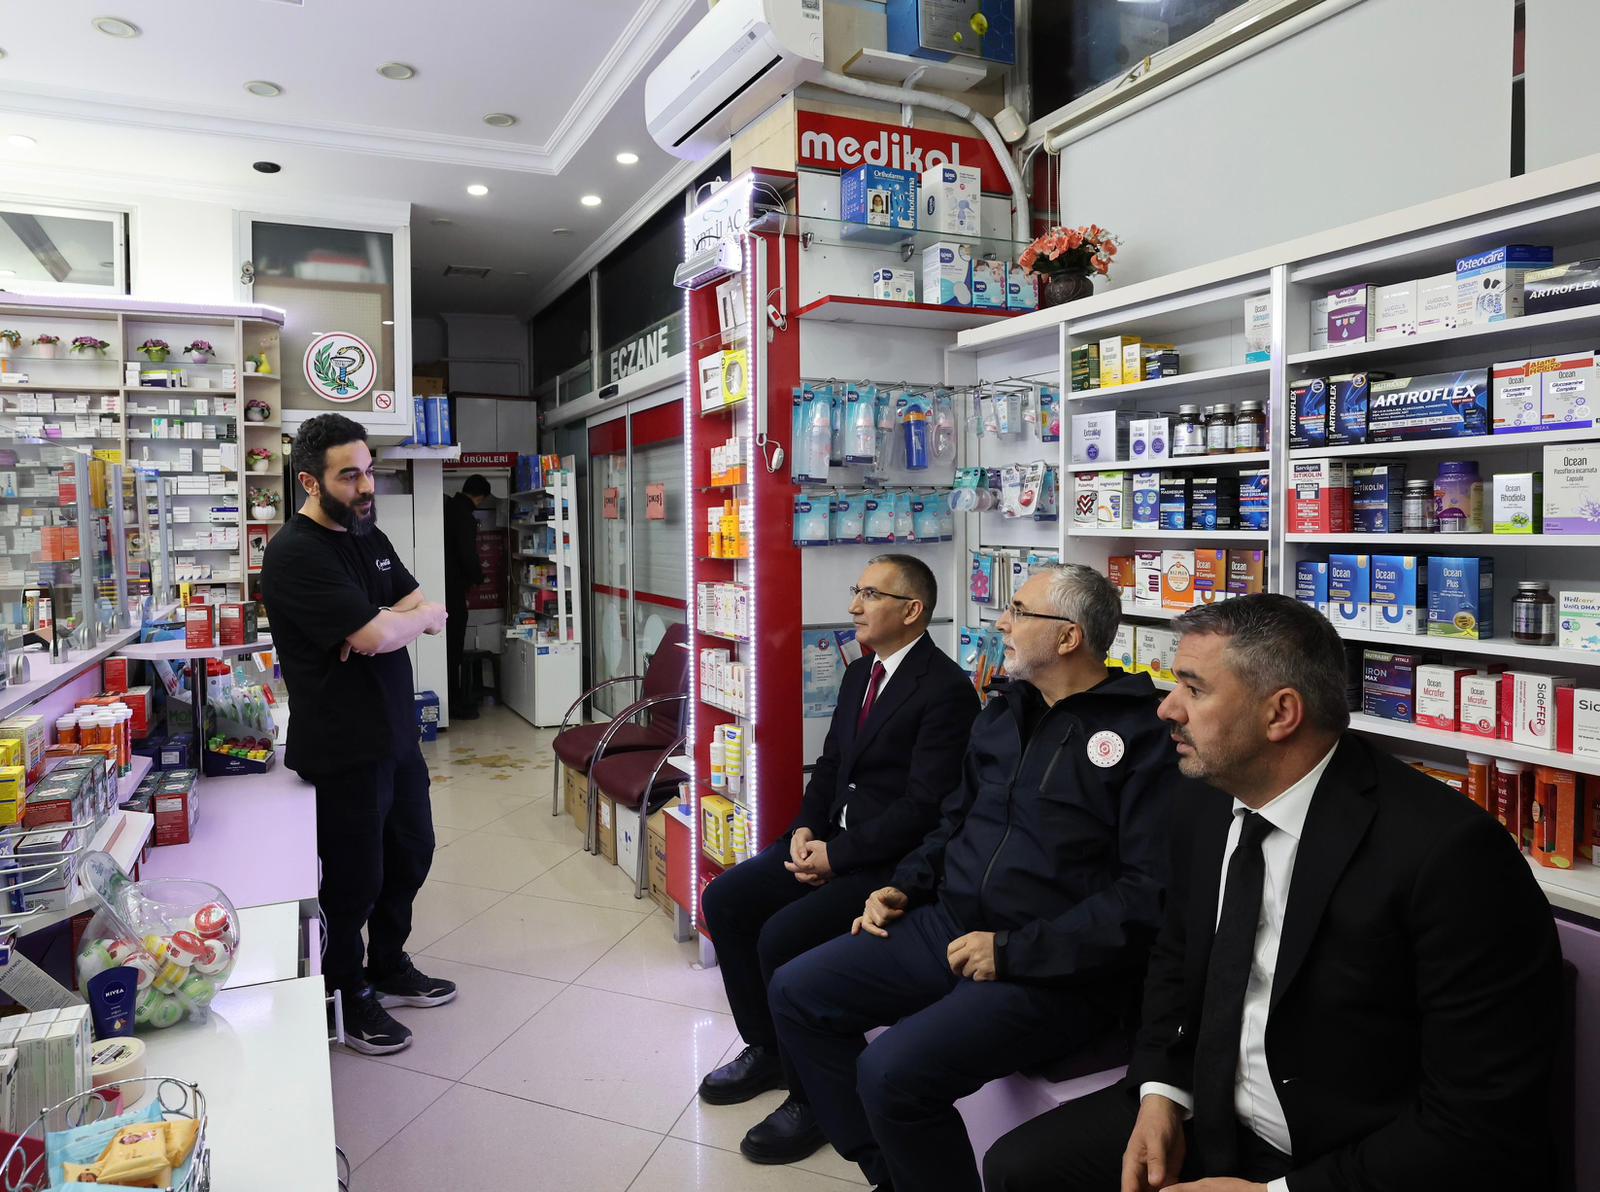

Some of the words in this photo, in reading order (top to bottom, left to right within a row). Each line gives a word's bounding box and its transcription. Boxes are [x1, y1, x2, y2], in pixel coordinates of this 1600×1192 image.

[801, 130, 960, 173] medikal
[1456, 250, 1505, 272] Osteocare
[1529, 279, 1600, 300] ARTROFLEX
[610, 325, 669, 383] ECZANE
[1558, 371, 1576, 379] Ocean
[1508, 377, 1524, 385] Ocean
[1373, 384, 1478, 408] ARTROFLEX
[1329, 384, 1337, 433] ARTROFLEX
[1563, 457, 1587, 466] Ocean
[1500, 494, 1526, 502] Rhodiola
[1298, 572, 1313, 581] Ocean
[1332, 568, 1351, 578] Ocean
[1376, 569, 1396, 580] Ocean
[1443, 567, 1463, 578] Ocean
[1446, 579, 1459, 588] Plus
[1365, 666, 1387, 677] IRON
[1537, 682, 1546, 726] SideFER
[105, 988, 124, 997] NIVEA
